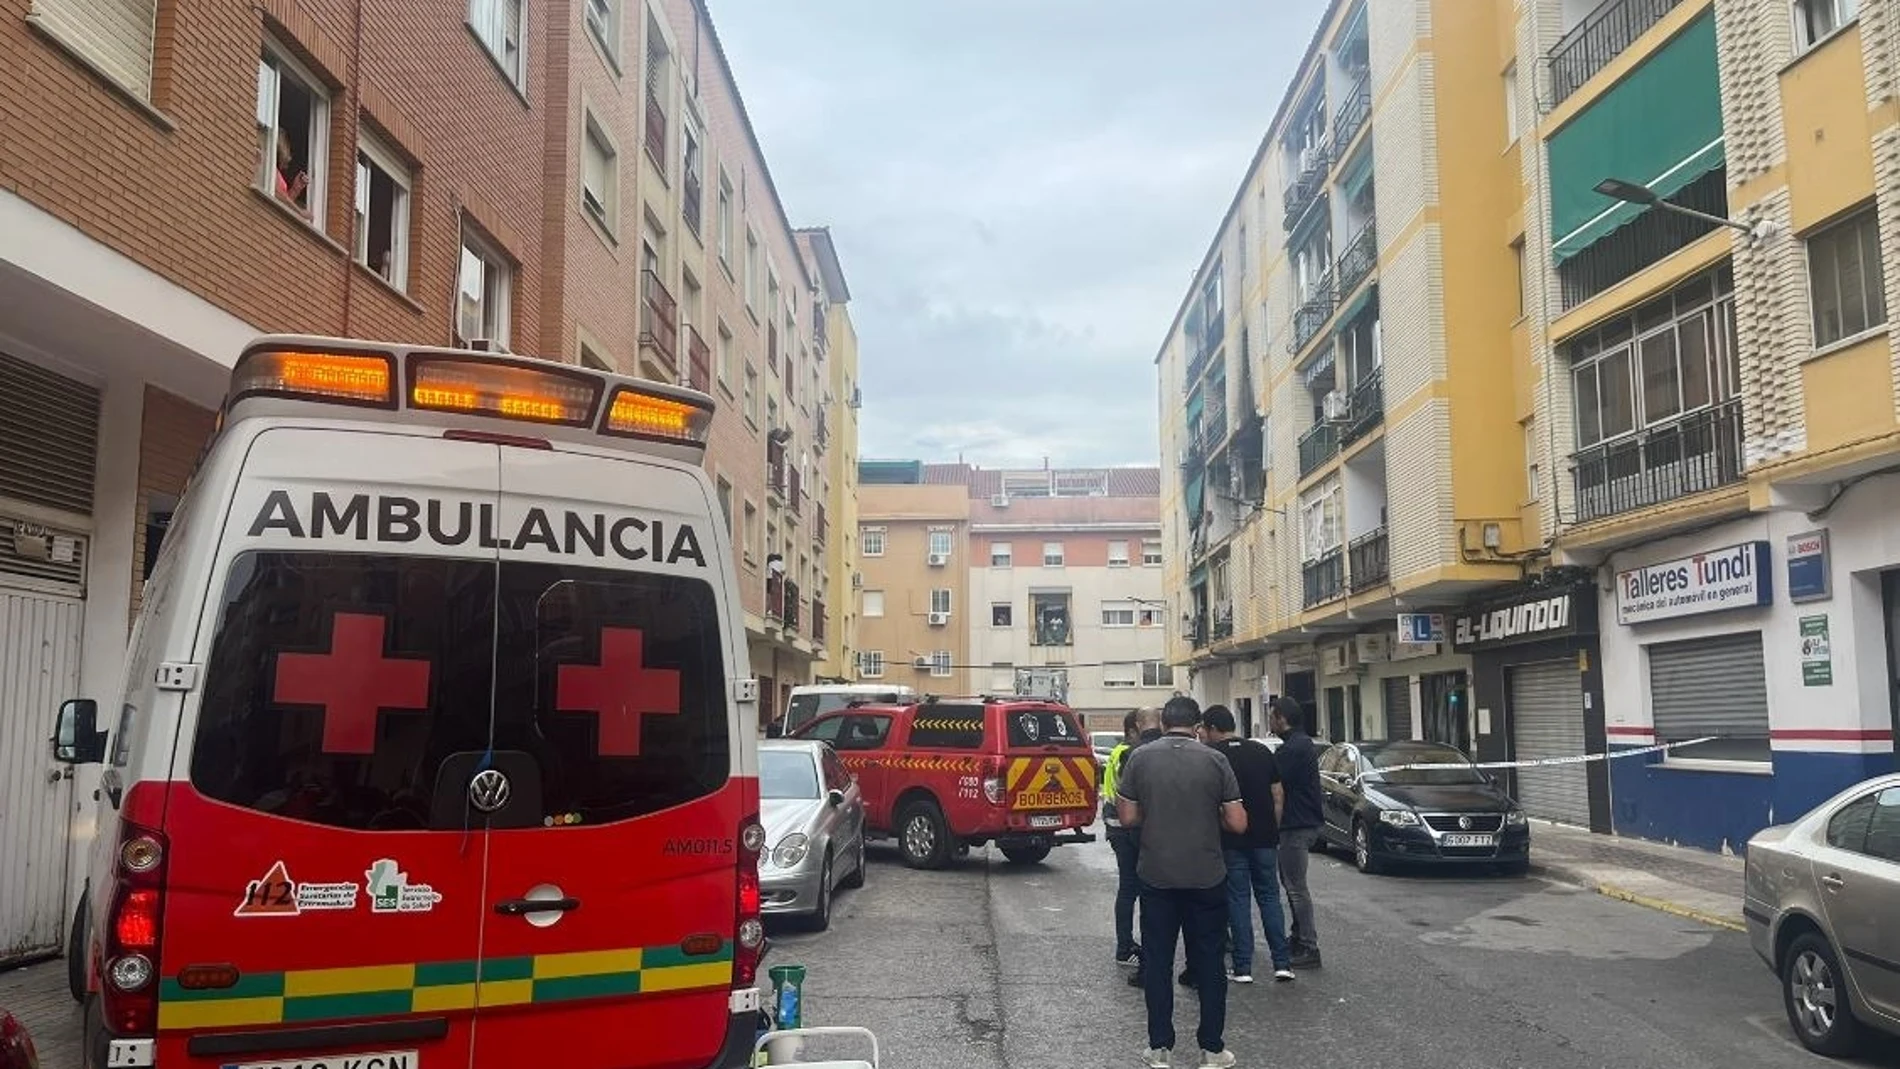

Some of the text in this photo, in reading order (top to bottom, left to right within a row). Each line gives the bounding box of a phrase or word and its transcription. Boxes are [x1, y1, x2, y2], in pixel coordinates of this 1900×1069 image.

[247, 489, 708, 568] AMBULANCIA
[1797, 540, 1820, 553] BOSCH
[1620, 545, 1751, 599] Talleres Tundi
[1656, 596, 1667, 608] del
[1707, 589, 1718, 600] en
[1719, 582, 1753, 601] general
[1417, 619, 1428, 638] L
[1019, 792, 1081, 807] BOMBEROS
[246, 881, 293, 906] 112
[375, 898, 397, 908] SES
